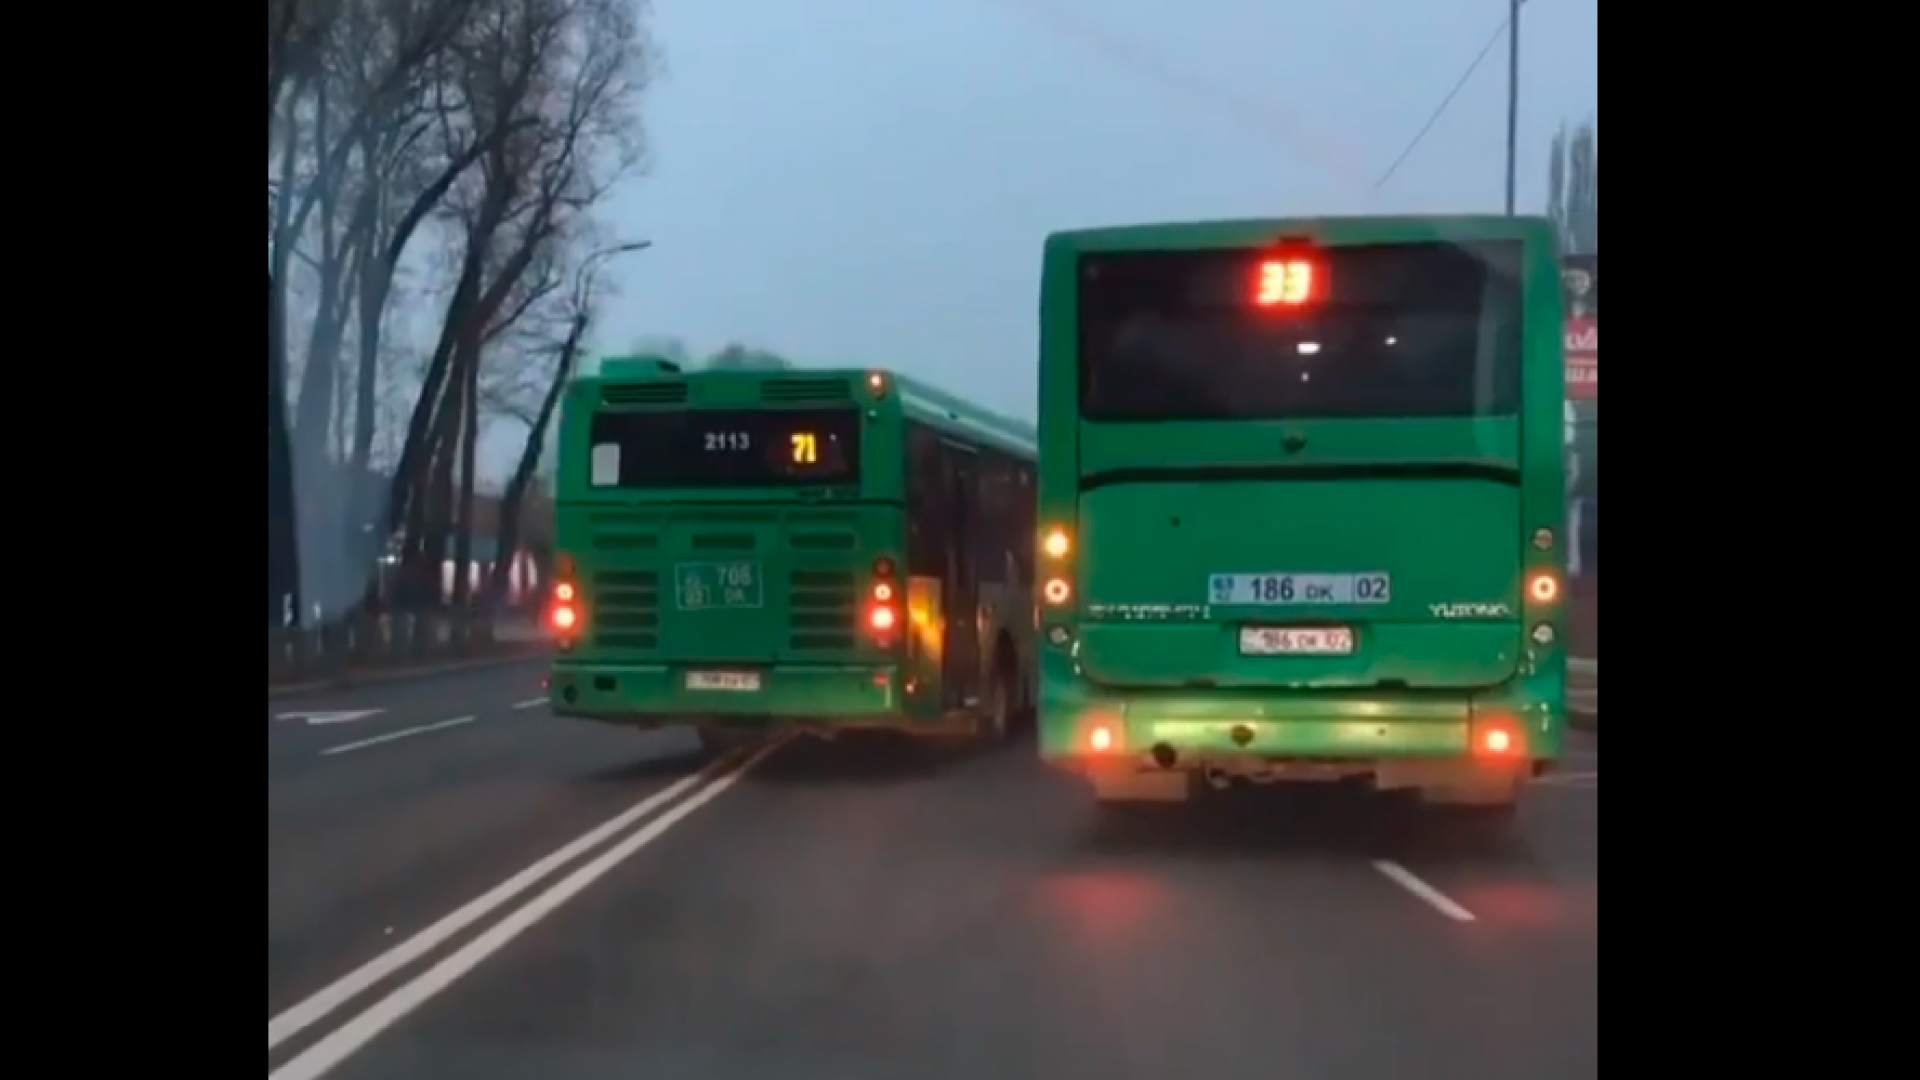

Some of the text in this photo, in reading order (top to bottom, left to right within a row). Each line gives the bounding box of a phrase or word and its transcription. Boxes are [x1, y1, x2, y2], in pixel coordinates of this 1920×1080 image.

[1257, 260, 1313, 304] 33
[704, 432, 750, 450] 2113
[790, 432, 817, 463] 71
[1251, 576, 1295, 600] 186
[1357, 577, 1387, 599] 02
